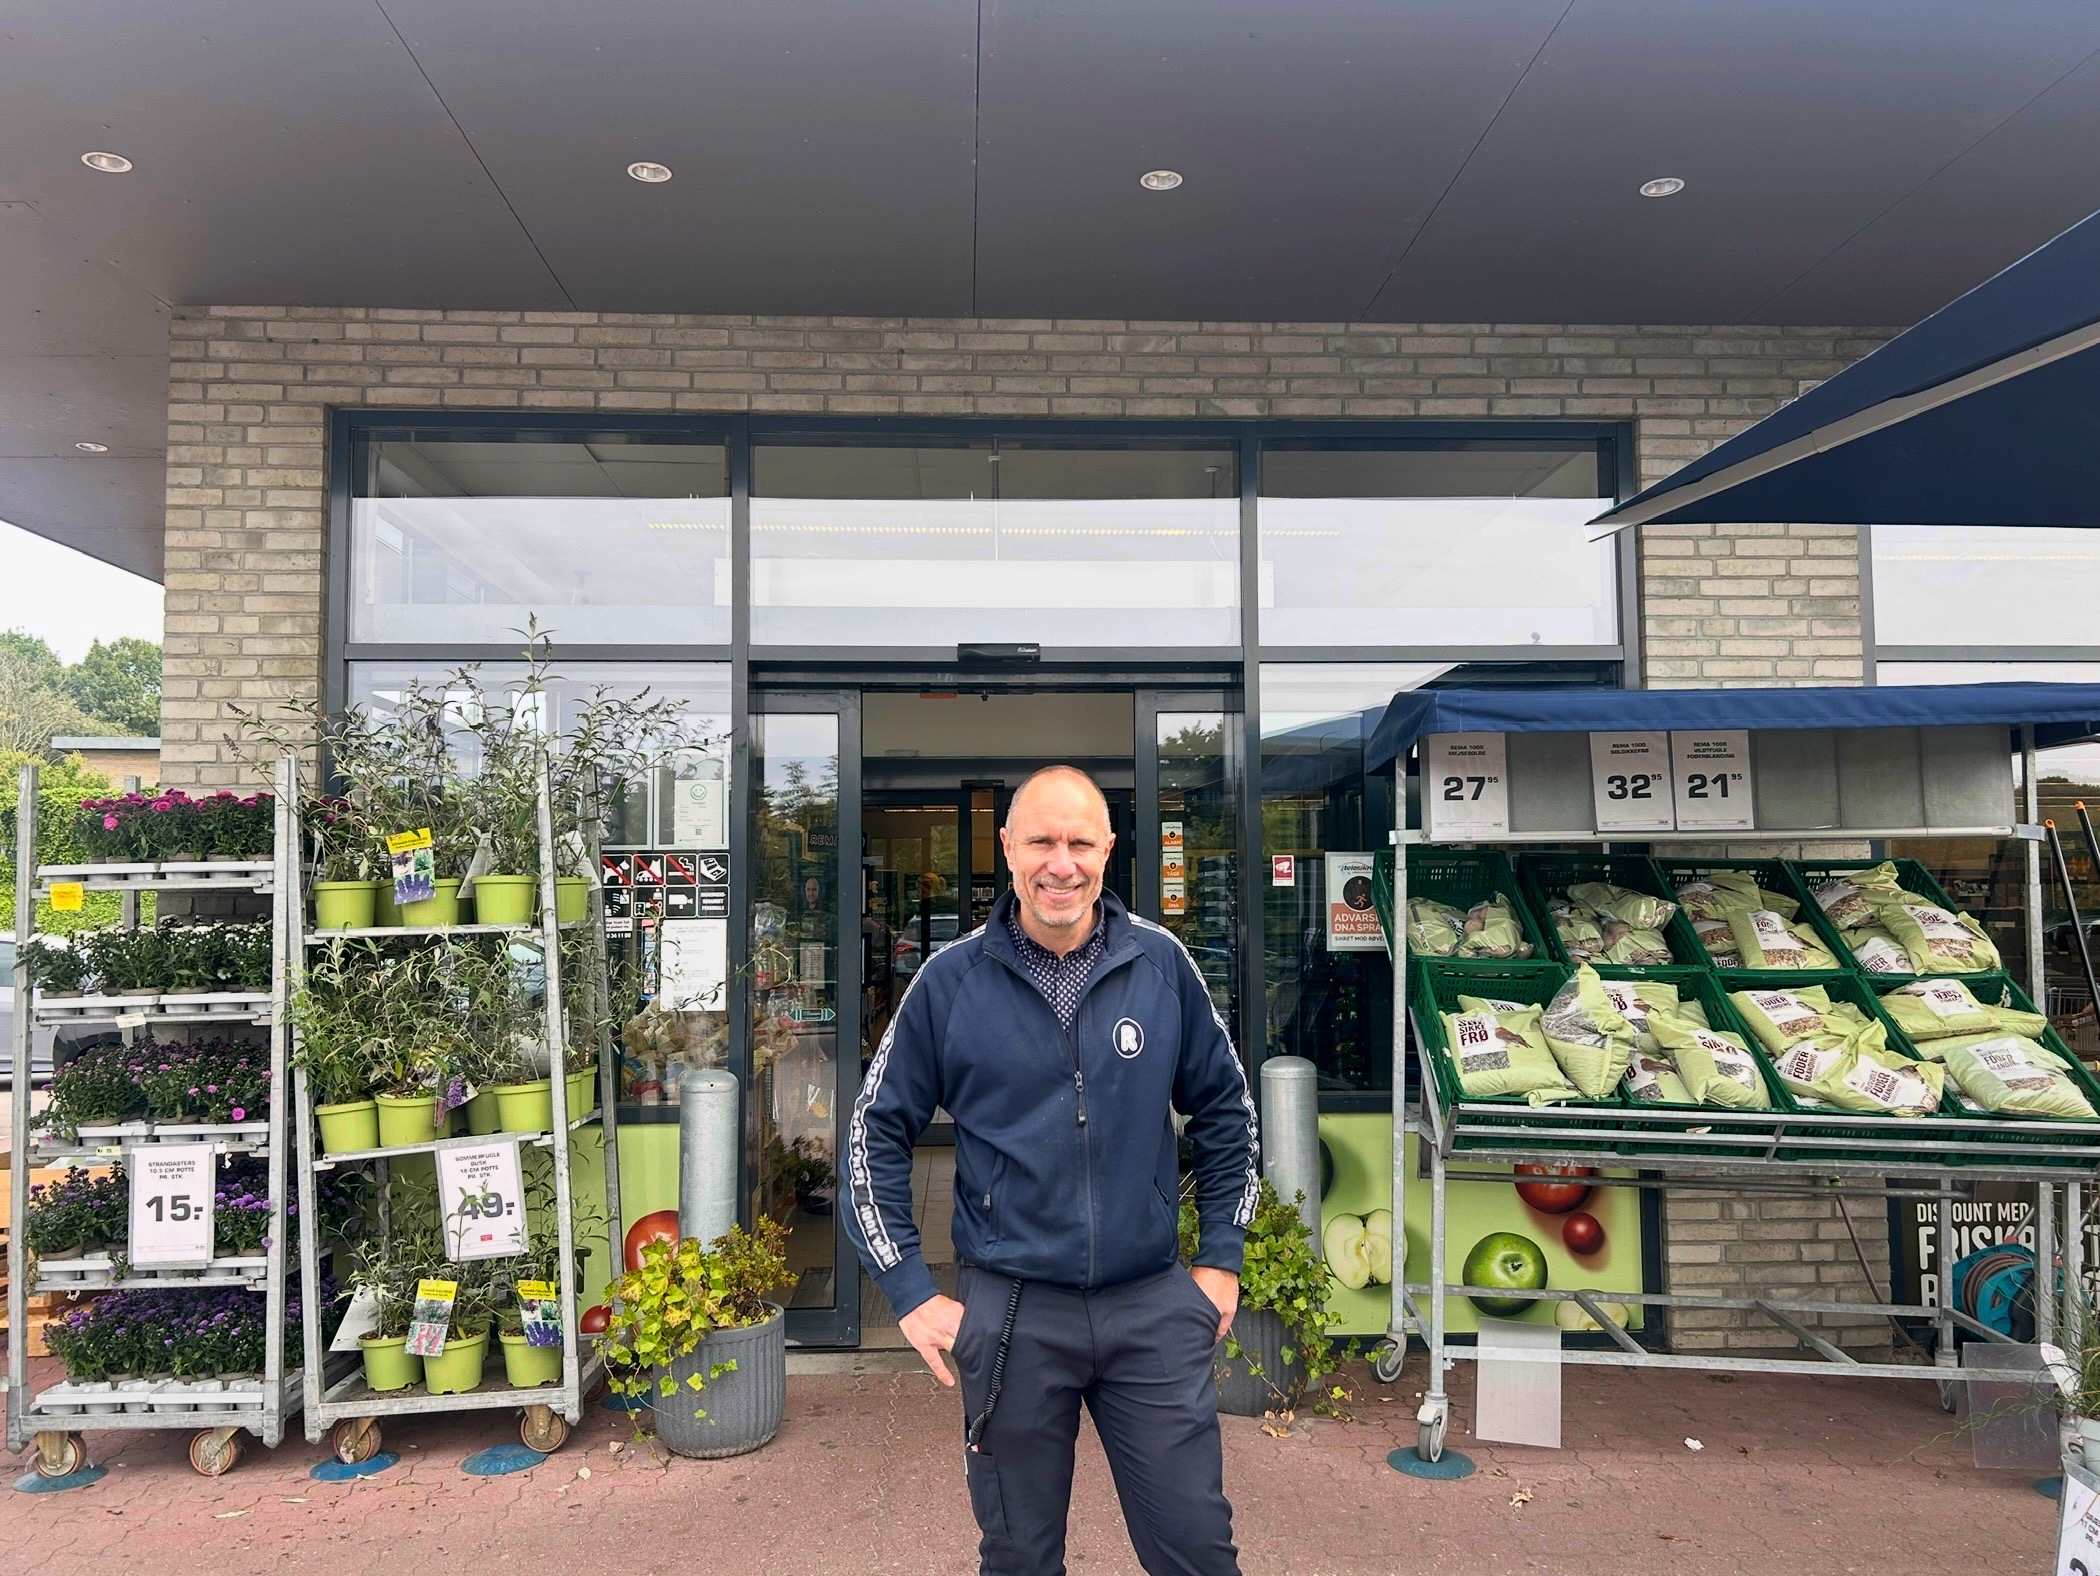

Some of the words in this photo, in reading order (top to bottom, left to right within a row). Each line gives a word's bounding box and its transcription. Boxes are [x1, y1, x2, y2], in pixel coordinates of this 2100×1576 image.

[1443, 776, 1486, 801] 27
[1607, 774, 1652, 800] 32
[1687, 773, 1729, 798] 21
[809, 834, 838, 846] REM
[1334, 923, 1355, 932] DNA
[1356, 923, 1381, 932] SPRA
[1121, 1024, 1138, 1052] R
[1460, 1029, 1489, 1047] FRØ
[1793, 1051, 1810, 1080] FODER
[1917, 1202, 1992, 1222] DISOUNT
